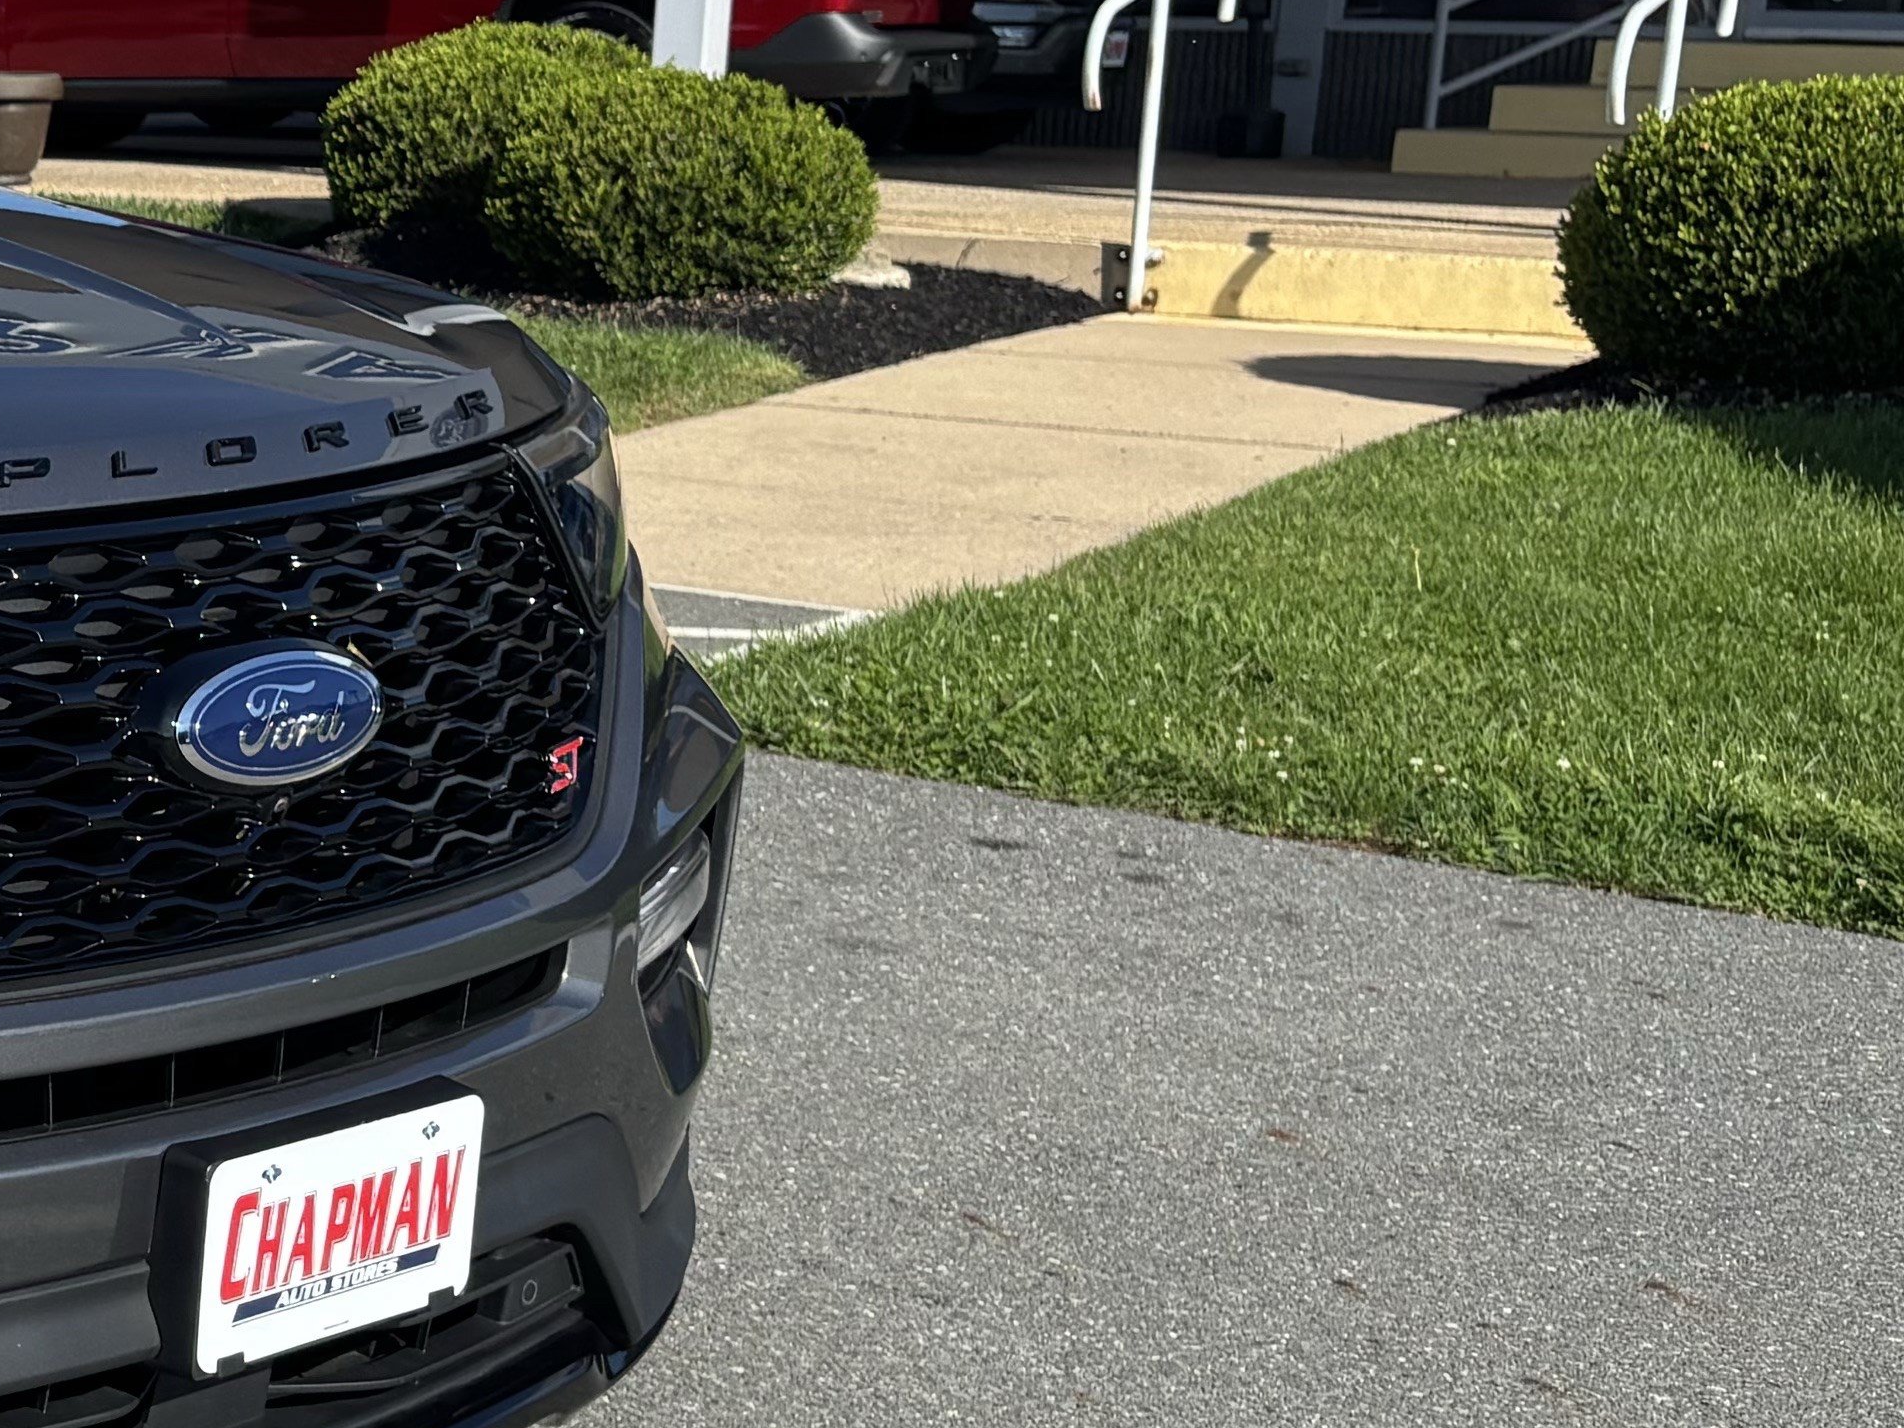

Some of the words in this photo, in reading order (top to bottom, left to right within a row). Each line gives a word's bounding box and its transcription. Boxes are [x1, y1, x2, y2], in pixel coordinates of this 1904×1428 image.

[237, 680, 346, 757] Ford
[219, 1143, 467, 1305] CHAPMAN
[274, 1275, 326, 1310] AUTO
[330, 1257, 399, 1292] STORES
